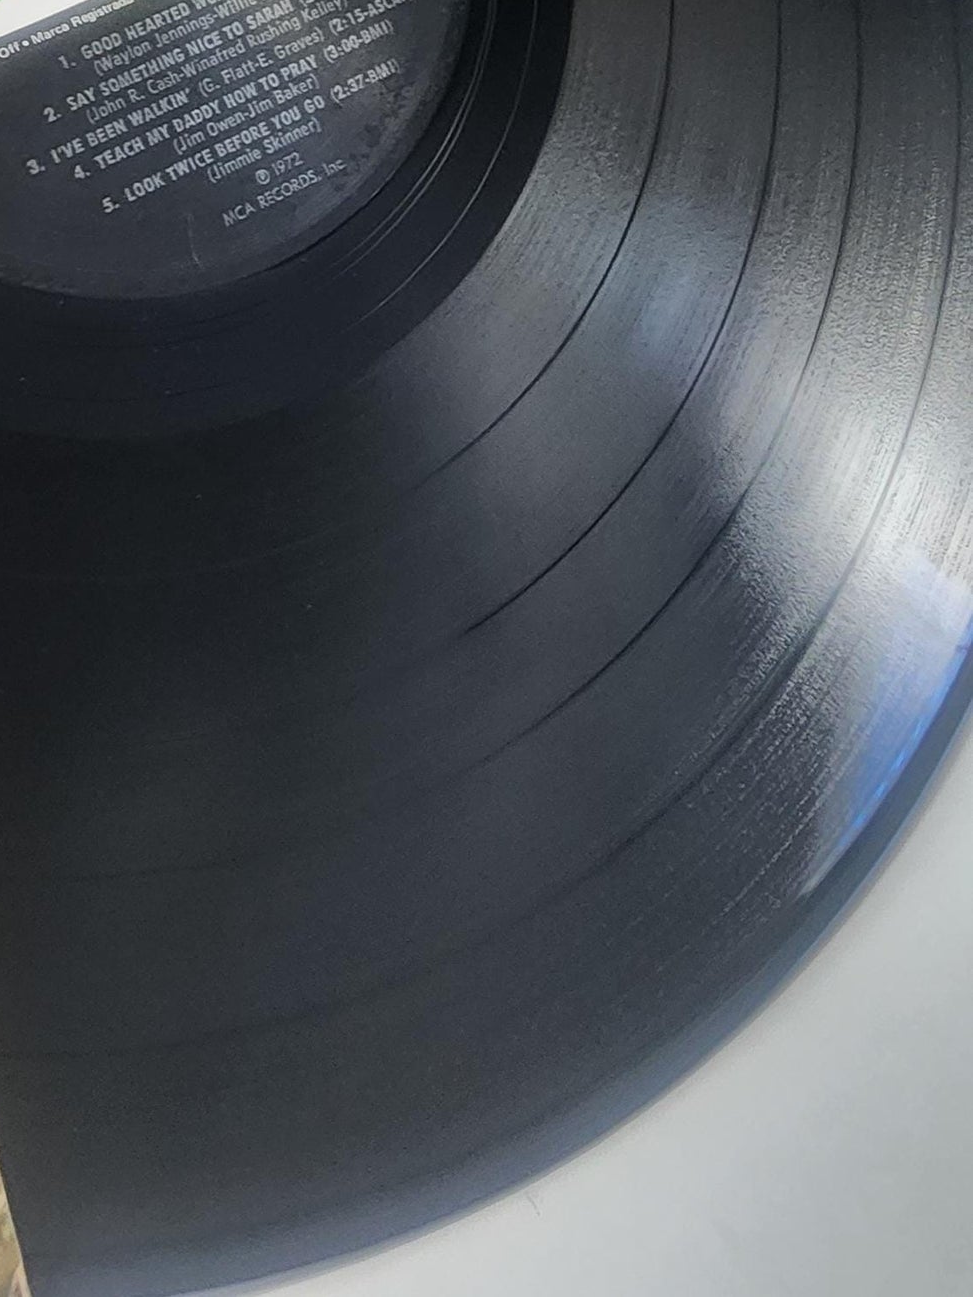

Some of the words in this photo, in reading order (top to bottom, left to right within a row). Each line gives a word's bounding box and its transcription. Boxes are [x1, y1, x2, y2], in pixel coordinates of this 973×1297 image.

[29, 23, 70, 45] Marca
[43, 106, 62, 123] 2.
[66, 86, 96, 111] SAY
[98, 47, 186, 97] SOMETHING
[185, 30, 223, 57] NICE
[221, 21, 245, 40] TO
[57, 55, 77, 69] 1.
[80, 32, 123, 60] GOOD
[124, 2, 192, 41] HEARTED
[86, 97, 127, 125] (John
[127, 88, 146, 103] R.
[146, 37, 247, 94] Cash-Winafred
[245, 15, 303, 48] Rushing
[93, 41, 153, 77] (Waylon
[26, 158, 46, 175] 3.
[50, 137, 86, 164] I'VE
[85, 118, 129, 147] BEEN
[126, 87, 193, 127] WALKIN'
[198, 77, 222, 98] (G.
[220, 52, 275, 85] Flatt-E.
[273, 26, 325, 60] Graves)
[74, 164, 91, 179] 4.
[92, 136, 146, 170] TEACH
[145, 123, 171, 147] MY
[171, 99, 222, 133] DADDY
[222, 81, 259, 109] HOW
[257, 72, 280, 91] TO
[279, 53, 318, 82] PRAY
[322, 19, 394, 64] (3:00-BMI)
[101, 196, 121, 213] 5.
[124, 171, 167, 202] LOOK
[164, 148, 215, 181] TWICE
[213, 121, 272, 158] BEFORE
[269, 105, 302, 130] YOU
[303, 95, 326, 114] GO
[328, 57, 401, 104] (2:37-BMI)
[172, 130, 207, 156] (Jim
[206, 98, 275, 137] Owen-Jim
[271, 72, 320, 105] Baker)
[206, 147, 263, 184] (Jimmie
[262, 116, 322, 154] Skinner)
[270, 151, 305, 176] 1972
[222, 202, 257, 227] MCA
